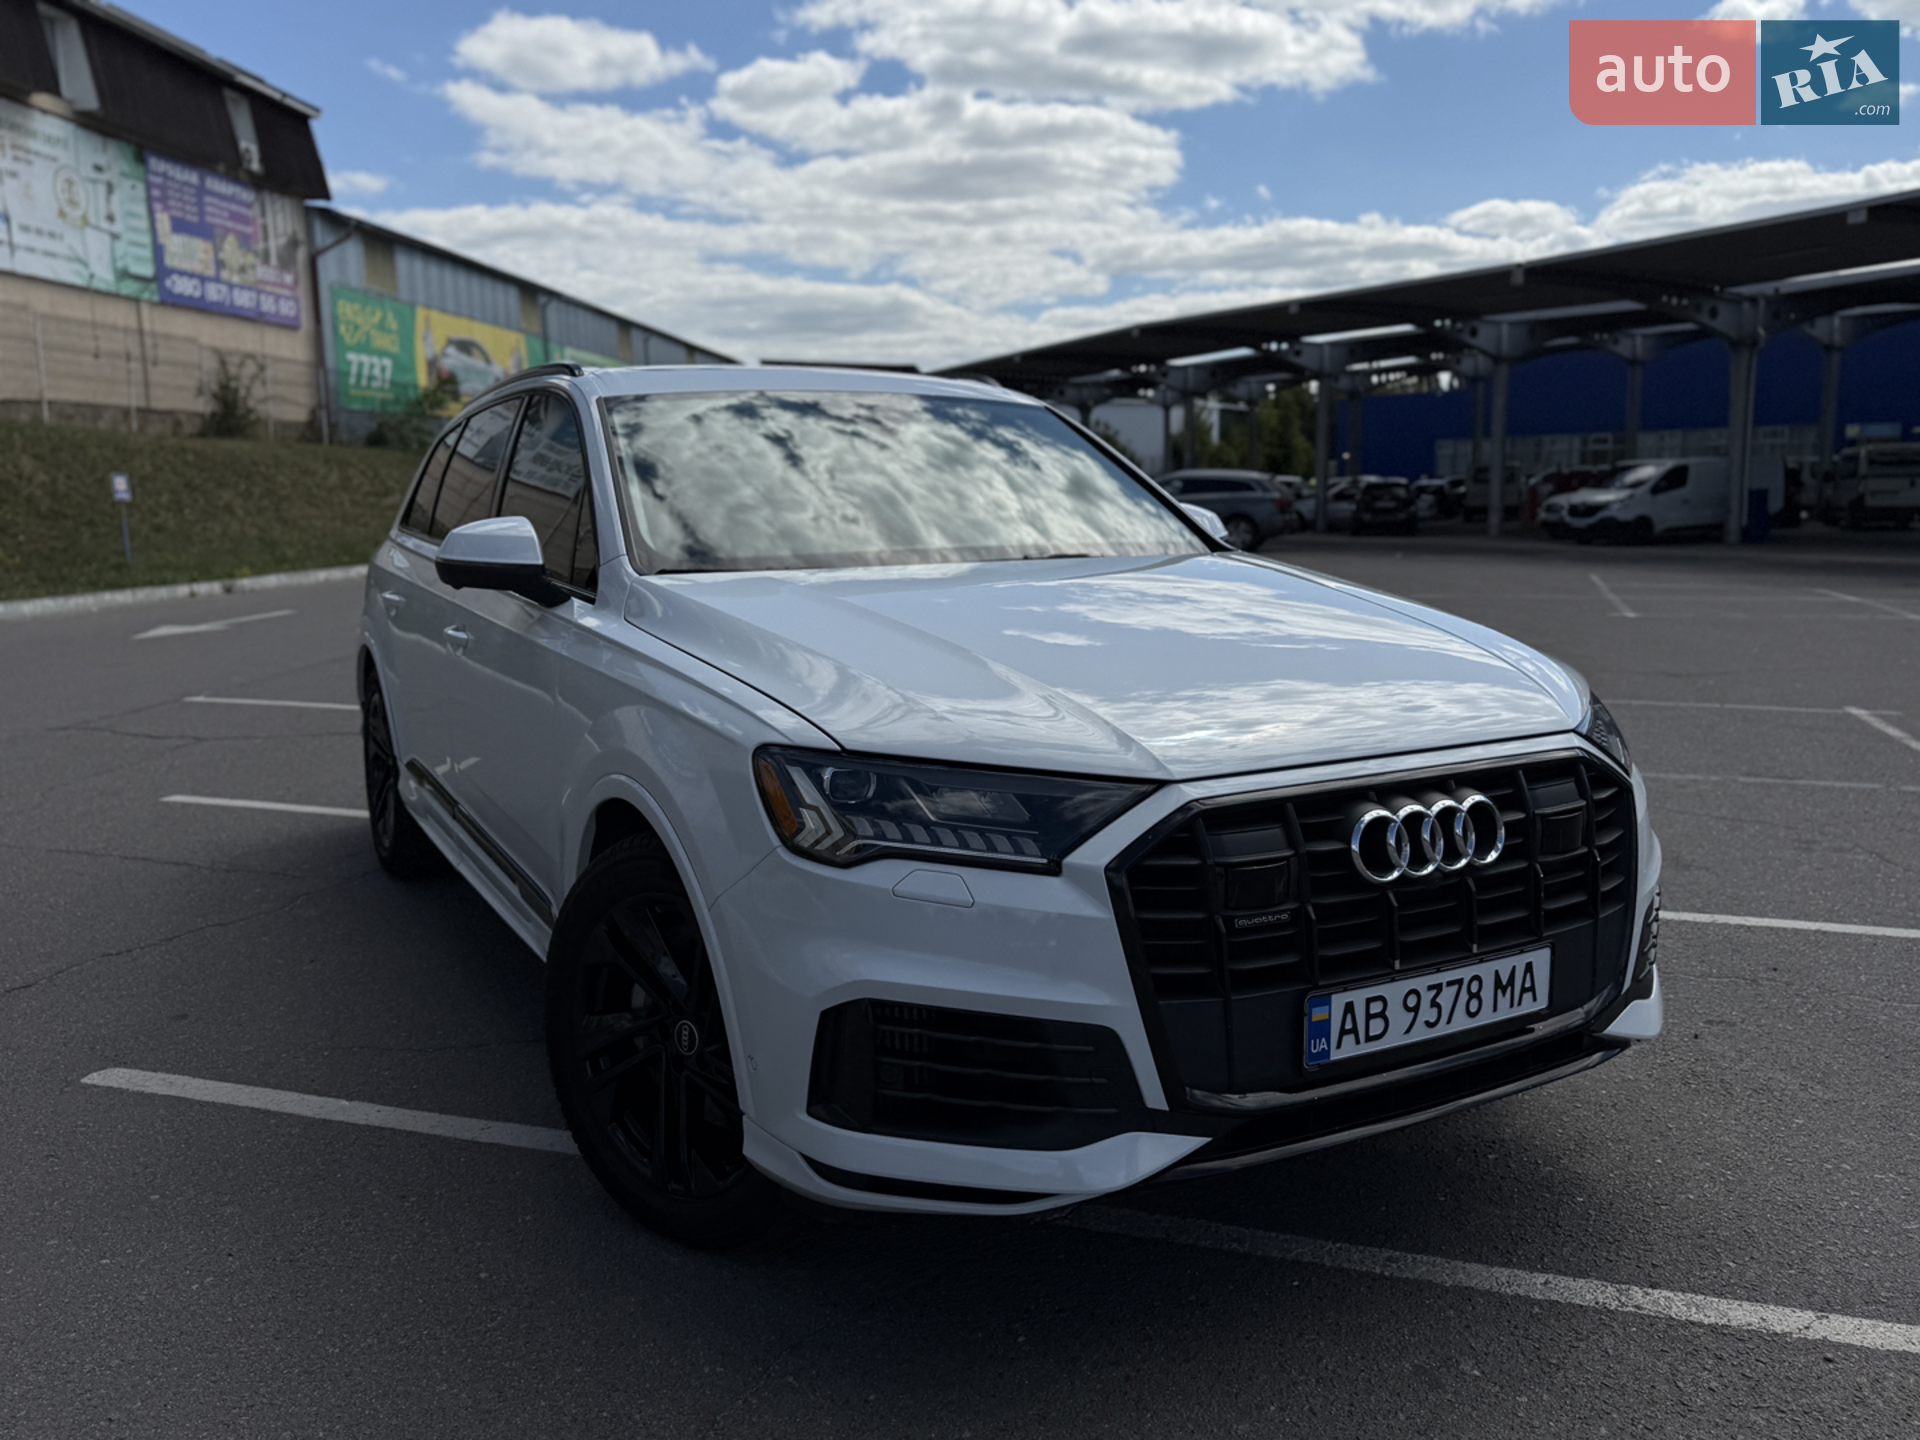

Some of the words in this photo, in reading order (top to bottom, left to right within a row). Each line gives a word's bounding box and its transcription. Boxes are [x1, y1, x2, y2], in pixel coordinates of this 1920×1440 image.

[345, 351, 393, 390] 7737
[1237, 912, 1290, 928] quattro
[1336, 994, 1390, 1050] AB
[1402, 974, 1484, 1036] 9378
[1492, 960, 1538, 1013] MA
[1311, 1037, 1328, 1054] UA
